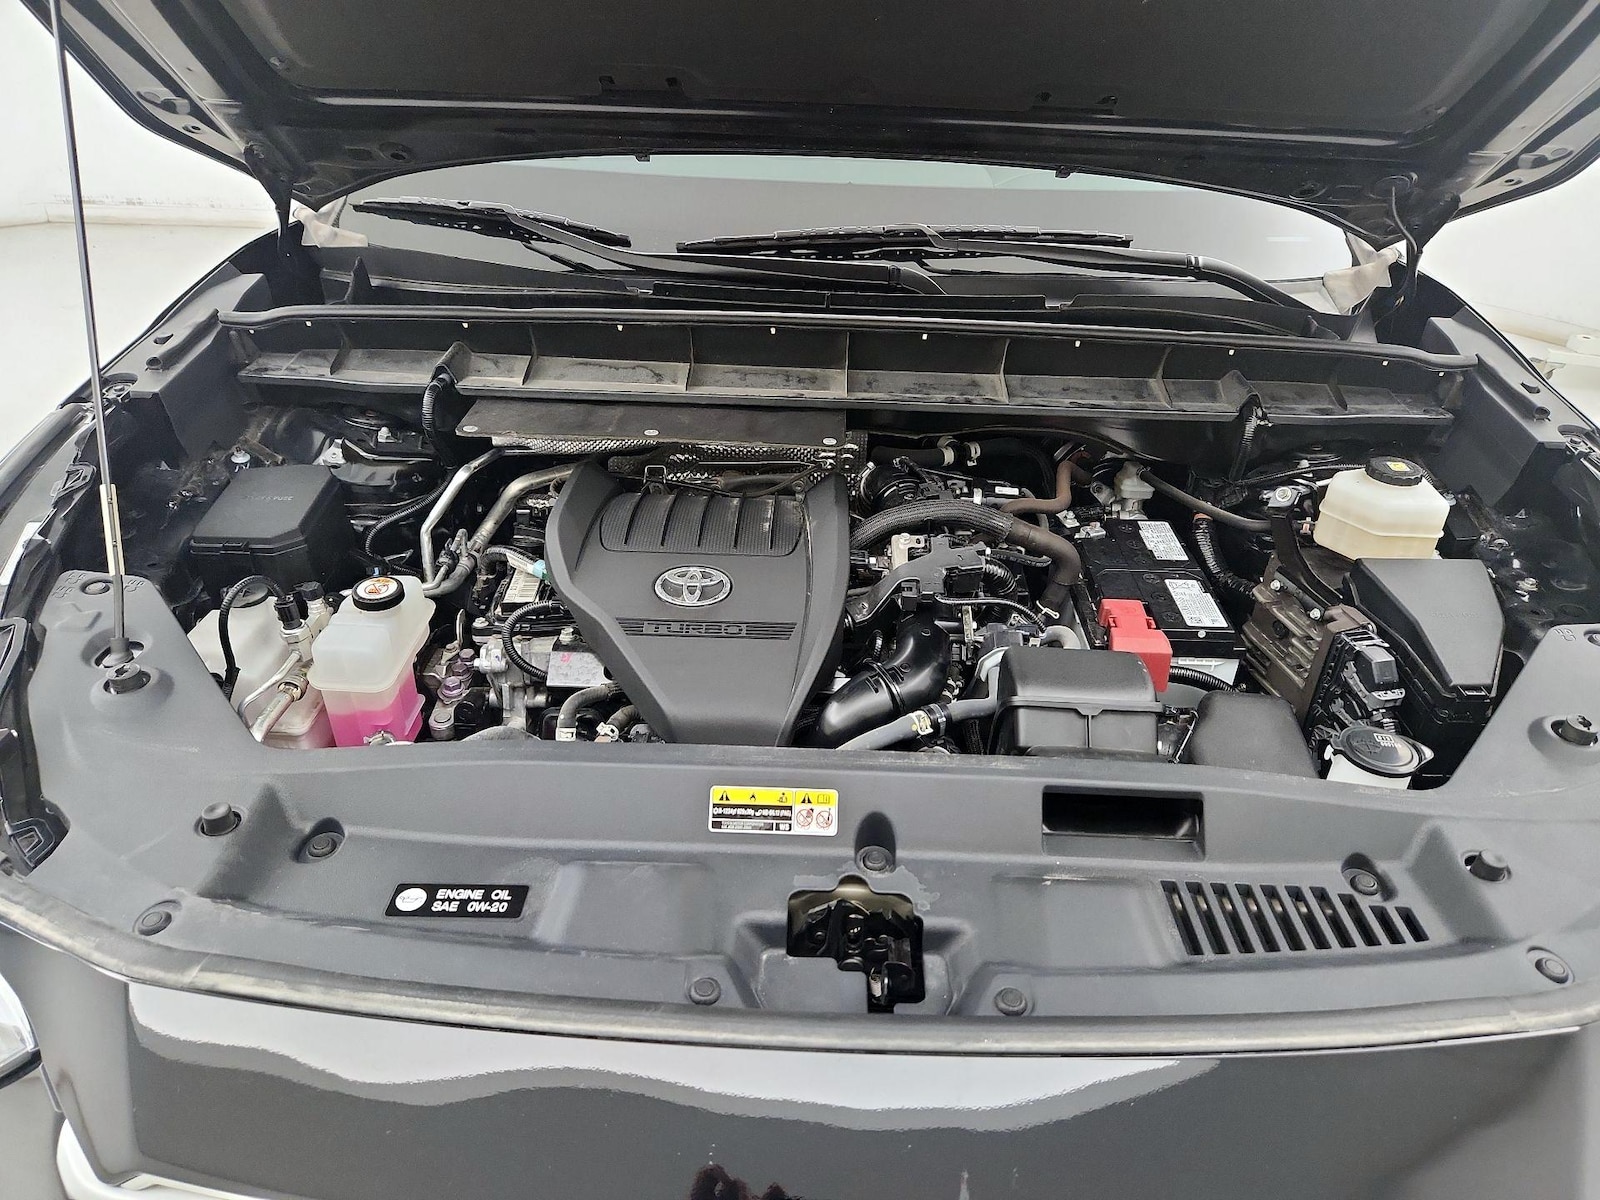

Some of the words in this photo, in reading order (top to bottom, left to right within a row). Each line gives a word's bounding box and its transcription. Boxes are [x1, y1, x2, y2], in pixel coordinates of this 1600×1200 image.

[645, 622, 745, 635] TURBO
[435, 888, 485, 900] ENGINE
[490, 889, 512, 900] OIL
[431, 901, 460, 912] SAE
[466, 901, 508, 913] 0W-20
